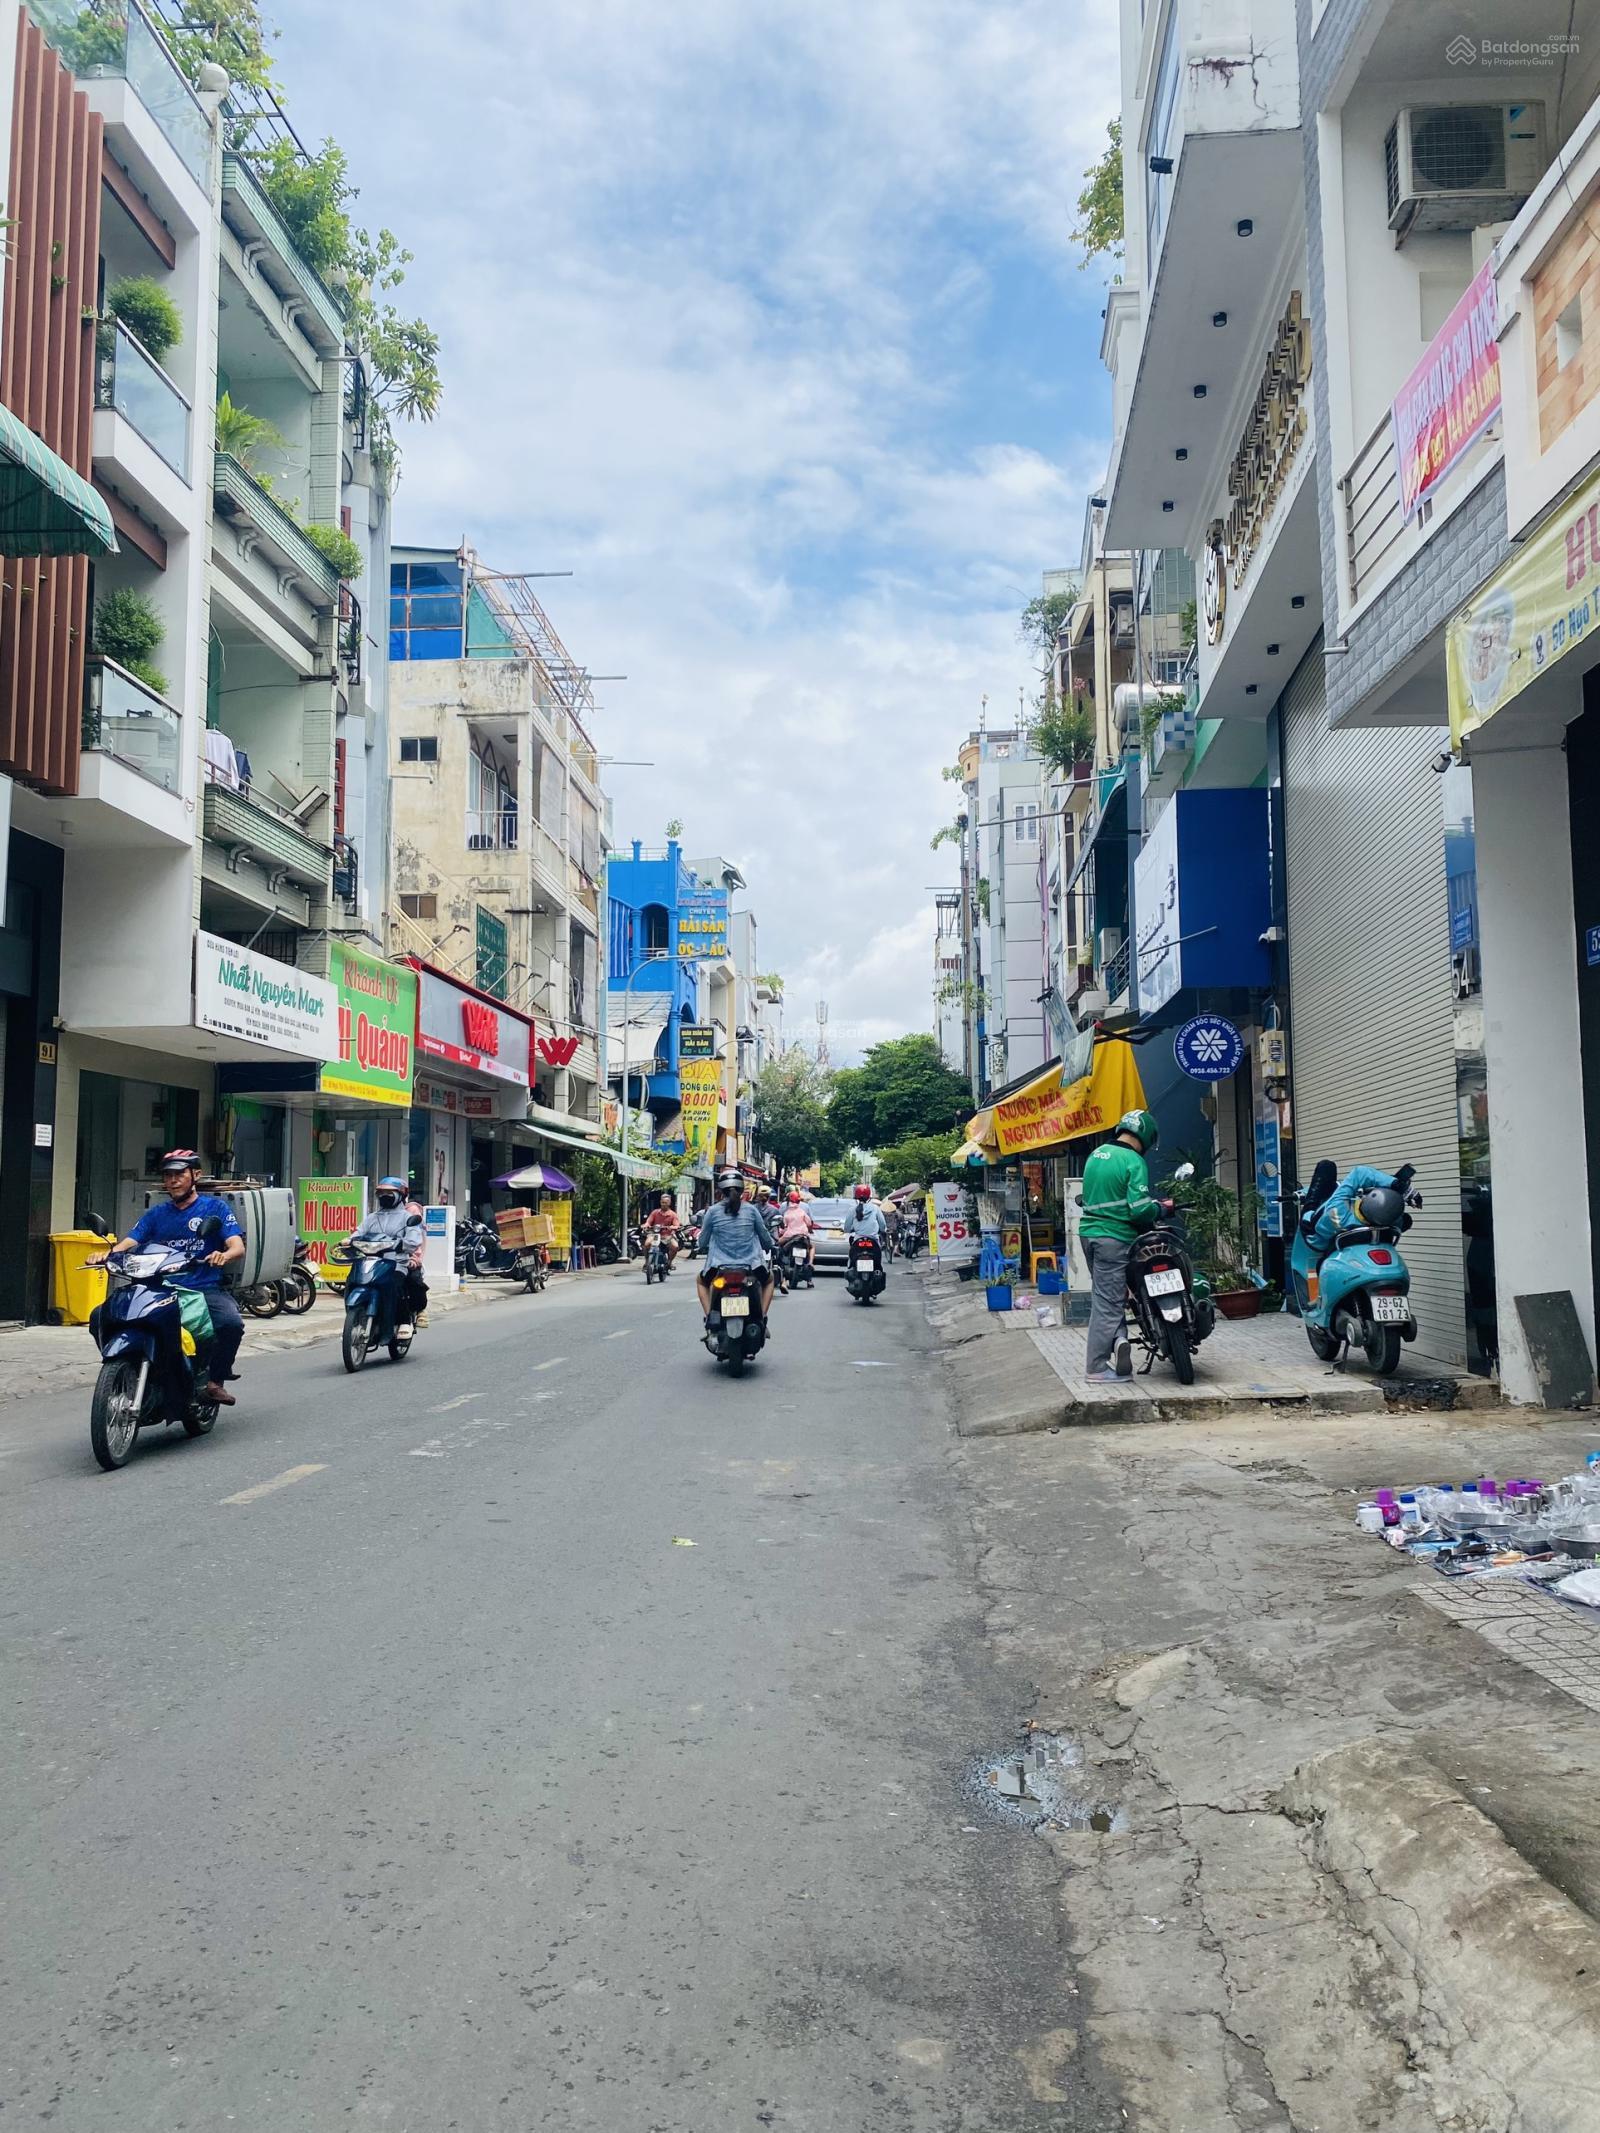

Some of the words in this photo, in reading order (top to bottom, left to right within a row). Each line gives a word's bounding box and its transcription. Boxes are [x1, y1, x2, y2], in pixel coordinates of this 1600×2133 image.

[218, 958, 251, 992] Nhất
[252, 970, 297, 1009] Nguyên
[298, 987, 325, 1017] Mart
[344, 957, 384, 1000] Khánh
[41, 1045, 53, 1059] 91
[357, 1015, 410, 1081] Quảng
[681, 1062, 718, 1080] BIA
[1093, 1150, 1111, 1160] Grab
[939, 1221, 967, 1240] 35
[1377, 1297, 1404, 1308] 29-G2
